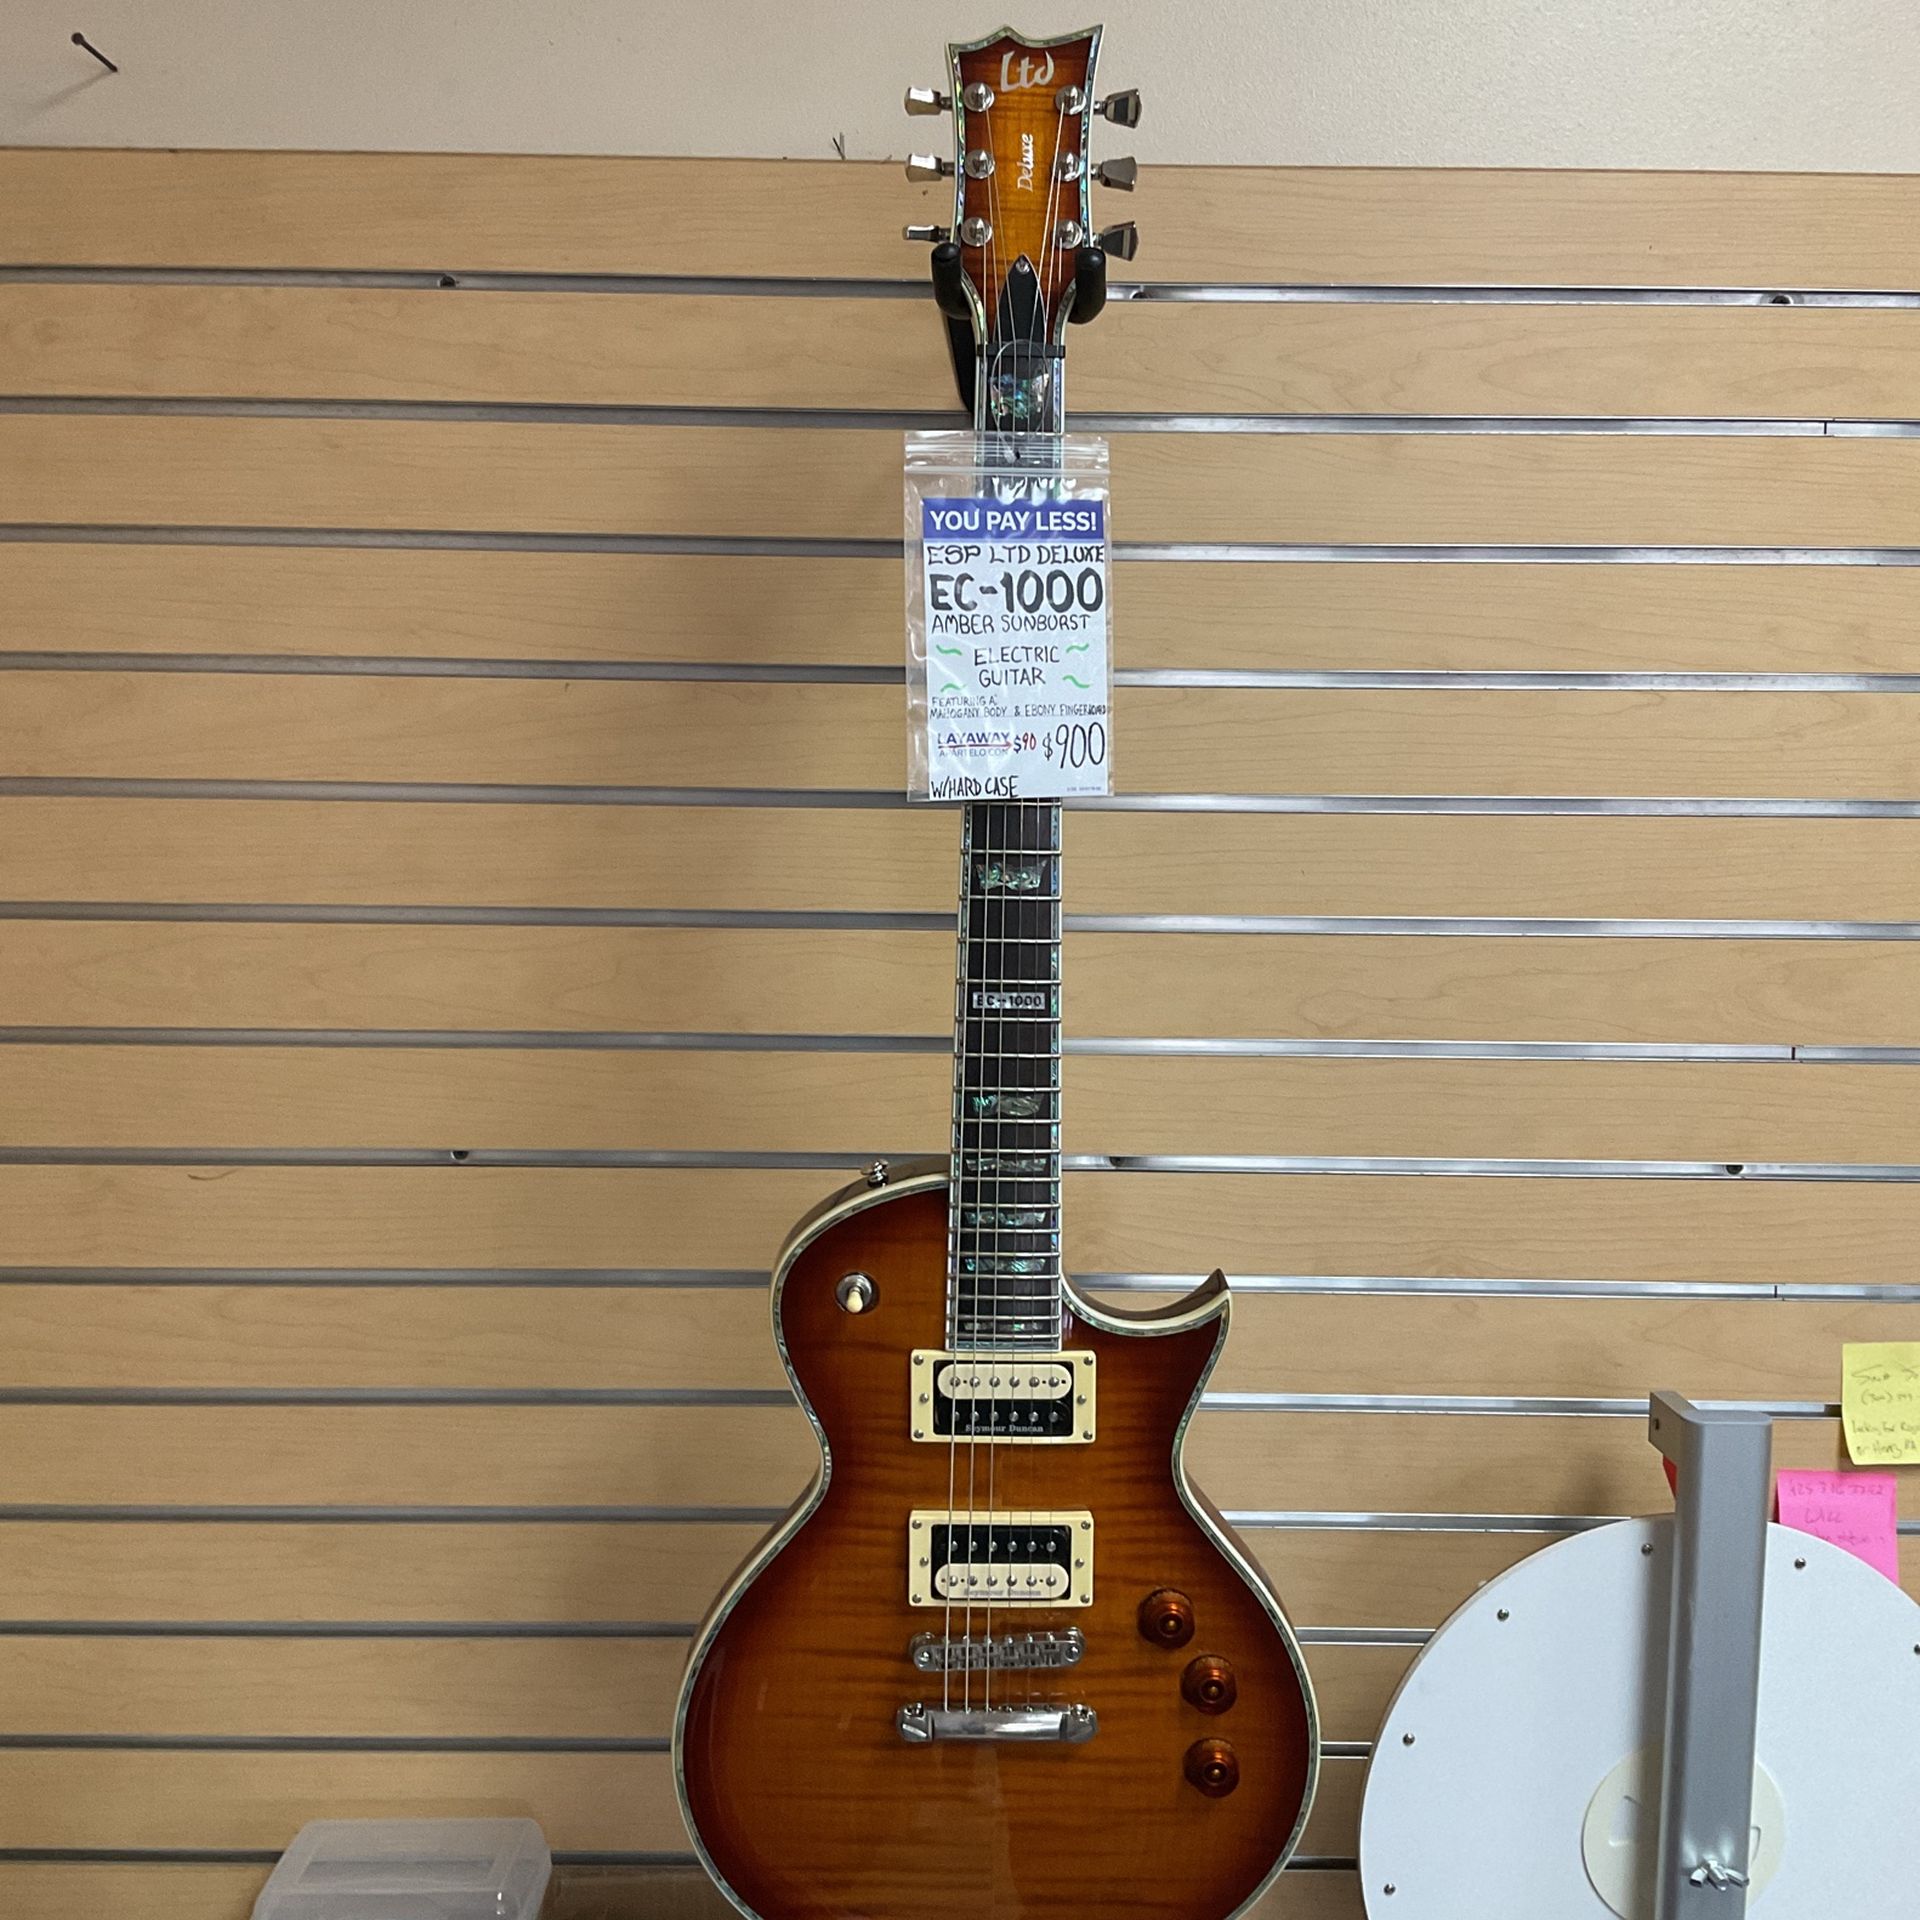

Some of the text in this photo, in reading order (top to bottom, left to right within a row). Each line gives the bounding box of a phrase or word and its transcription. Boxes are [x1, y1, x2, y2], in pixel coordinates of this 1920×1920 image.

[1017, 133, 1034, 192] Deluxe
[929, 510, 1096, 531] YOU PAY LESS!
[927, 545, 1105, 565] ESP LTD DELUXE
[929, 567, 1103, 613] EC-1000
[931, 614, 1092, 635] AMBER SUNBURST
[974, 646, 1060, 666] ELECTRIC
[979, 667, 1046, 688] GUITAR
[984, 706, 1007, 718] BODY
[1014, 705, 1020, 717] &
[1025, 703, 1056, 717] EBONY
[938, 721, 1105, 769] LAYAWAY $90 $900
[931, 775, 1019, 799] W/HARD CASE
[977, 995, 1042, 1007] EC-1000
[965, 1424, 1044, 1433] Seymour Duncan
